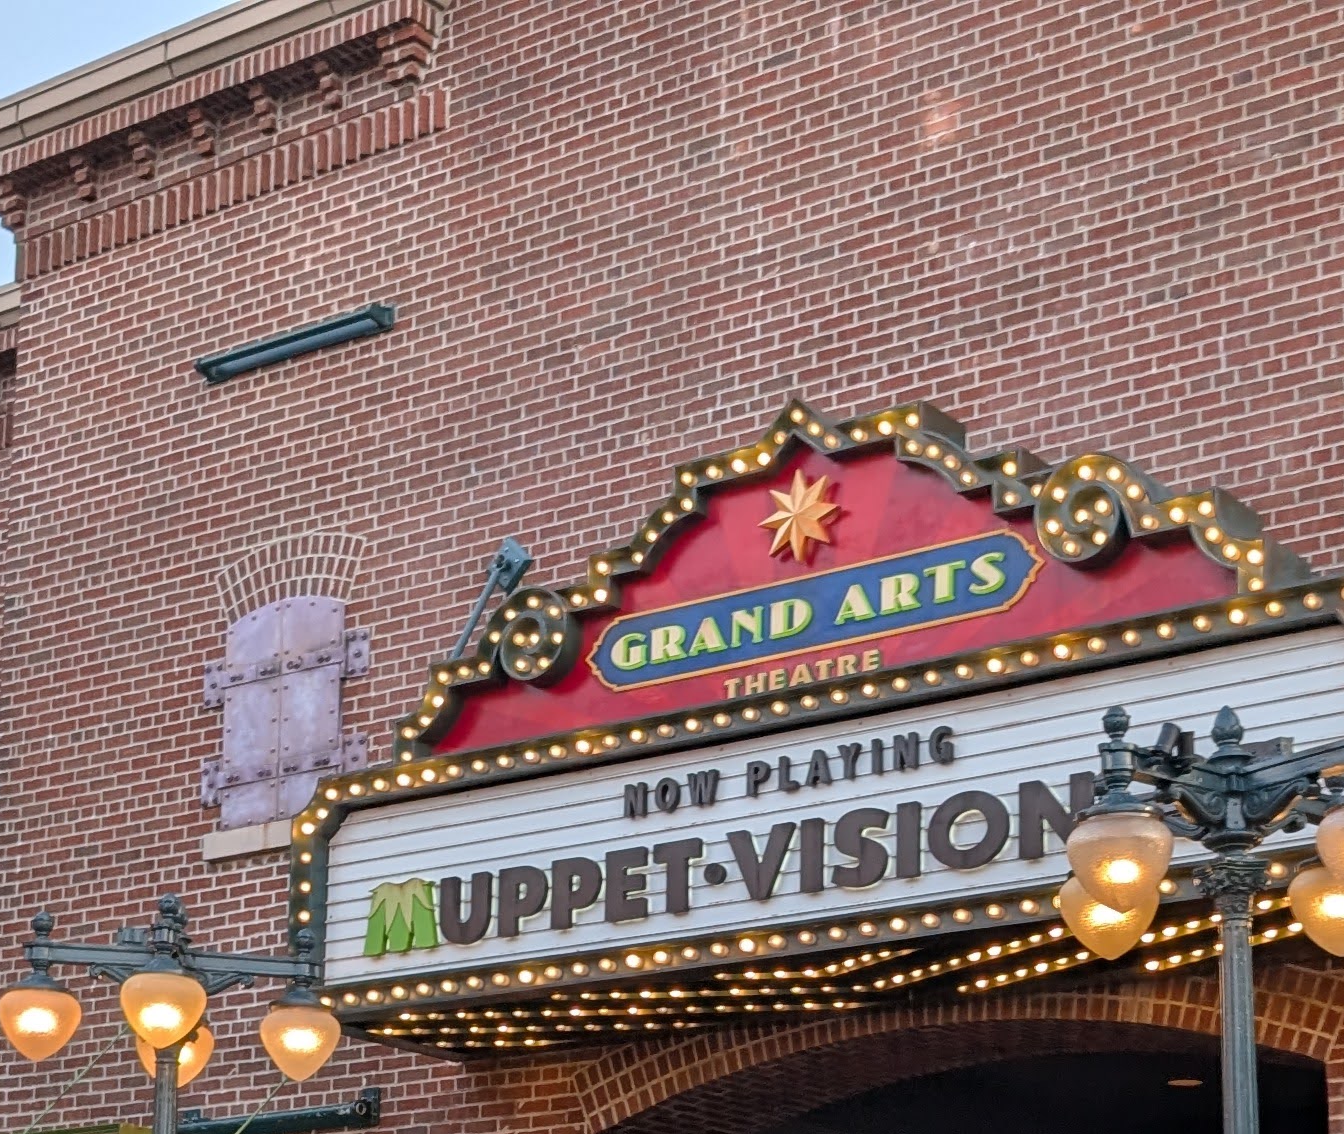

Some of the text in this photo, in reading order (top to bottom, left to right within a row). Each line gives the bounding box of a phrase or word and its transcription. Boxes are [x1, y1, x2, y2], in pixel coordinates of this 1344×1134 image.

[610, 551, 1007, 672] GRAND ARTS
[723, 648, 885, 699] THEATRE
[623, 726, 954, 818] NOW PLAYING
